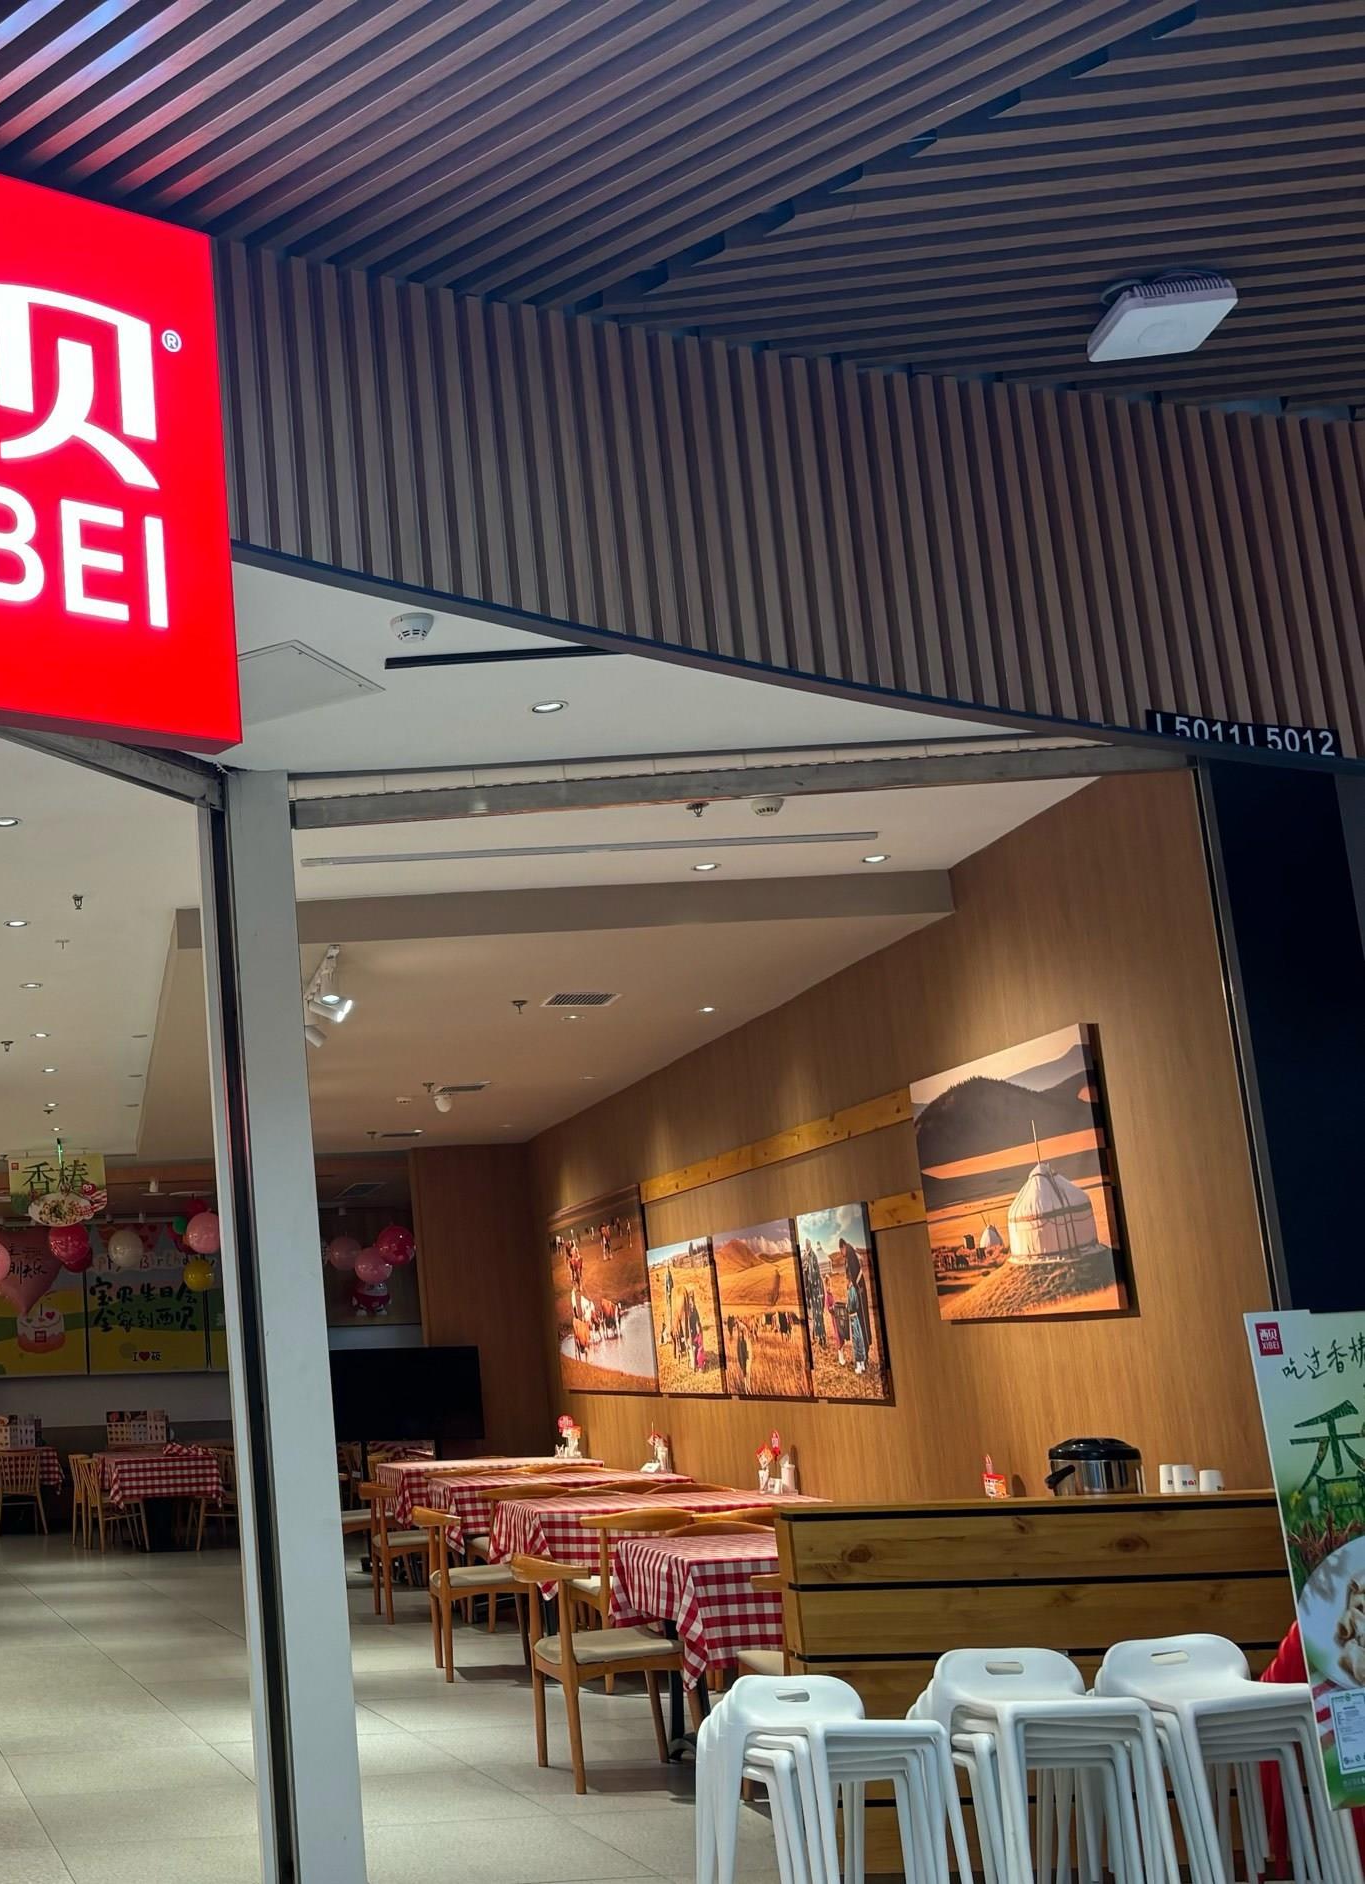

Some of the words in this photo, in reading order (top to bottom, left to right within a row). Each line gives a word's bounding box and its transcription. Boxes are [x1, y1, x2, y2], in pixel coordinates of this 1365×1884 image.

[22, 1159, 89, 1194] 香椿
[1259, 1328, 1278, 1341] 西贝
[1261, 1341, 1280, 1350] XIBEI
